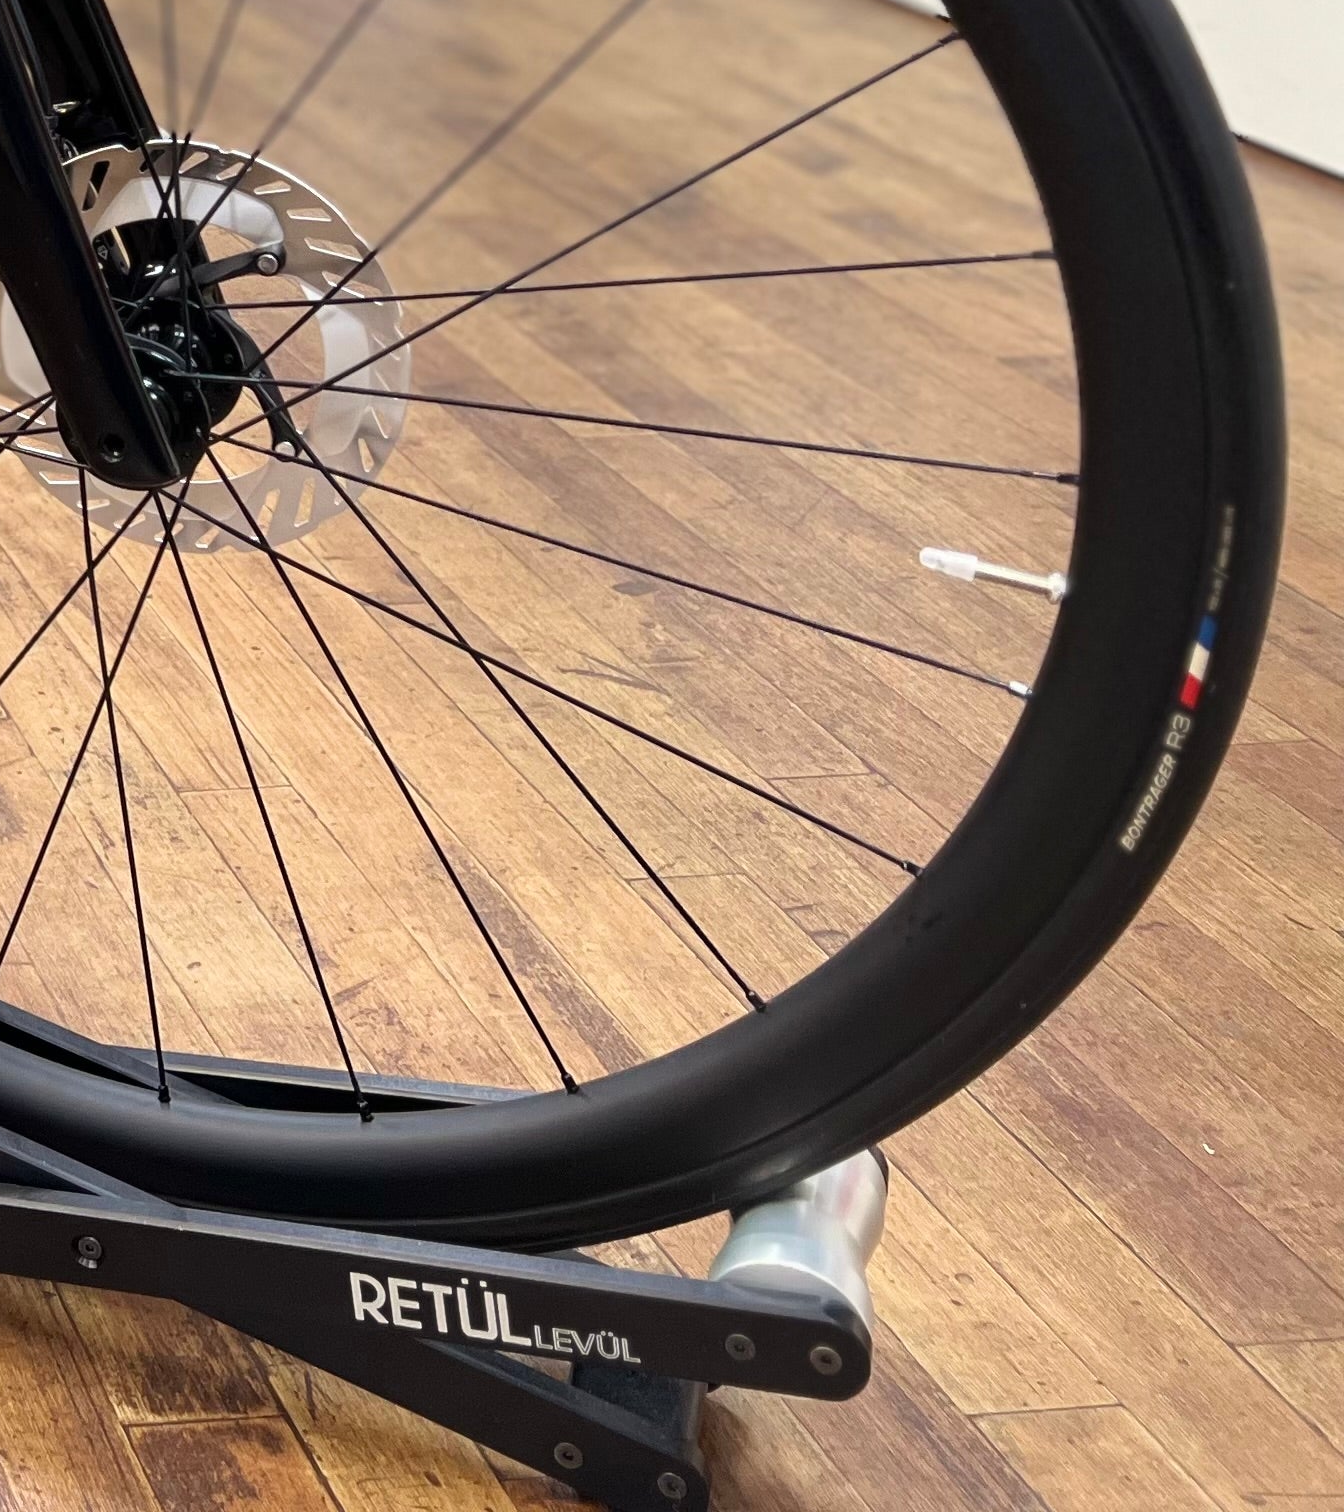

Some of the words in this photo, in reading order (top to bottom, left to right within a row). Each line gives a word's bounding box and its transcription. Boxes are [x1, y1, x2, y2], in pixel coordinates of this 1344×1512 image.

[1120, 752, 1177, 852] BONTRAGER
[1165, 713, 1192, 750] R3
[349, 1271, 533, 1347] RETÜL
[533, 1324, 641, 1364] LEVÜL
